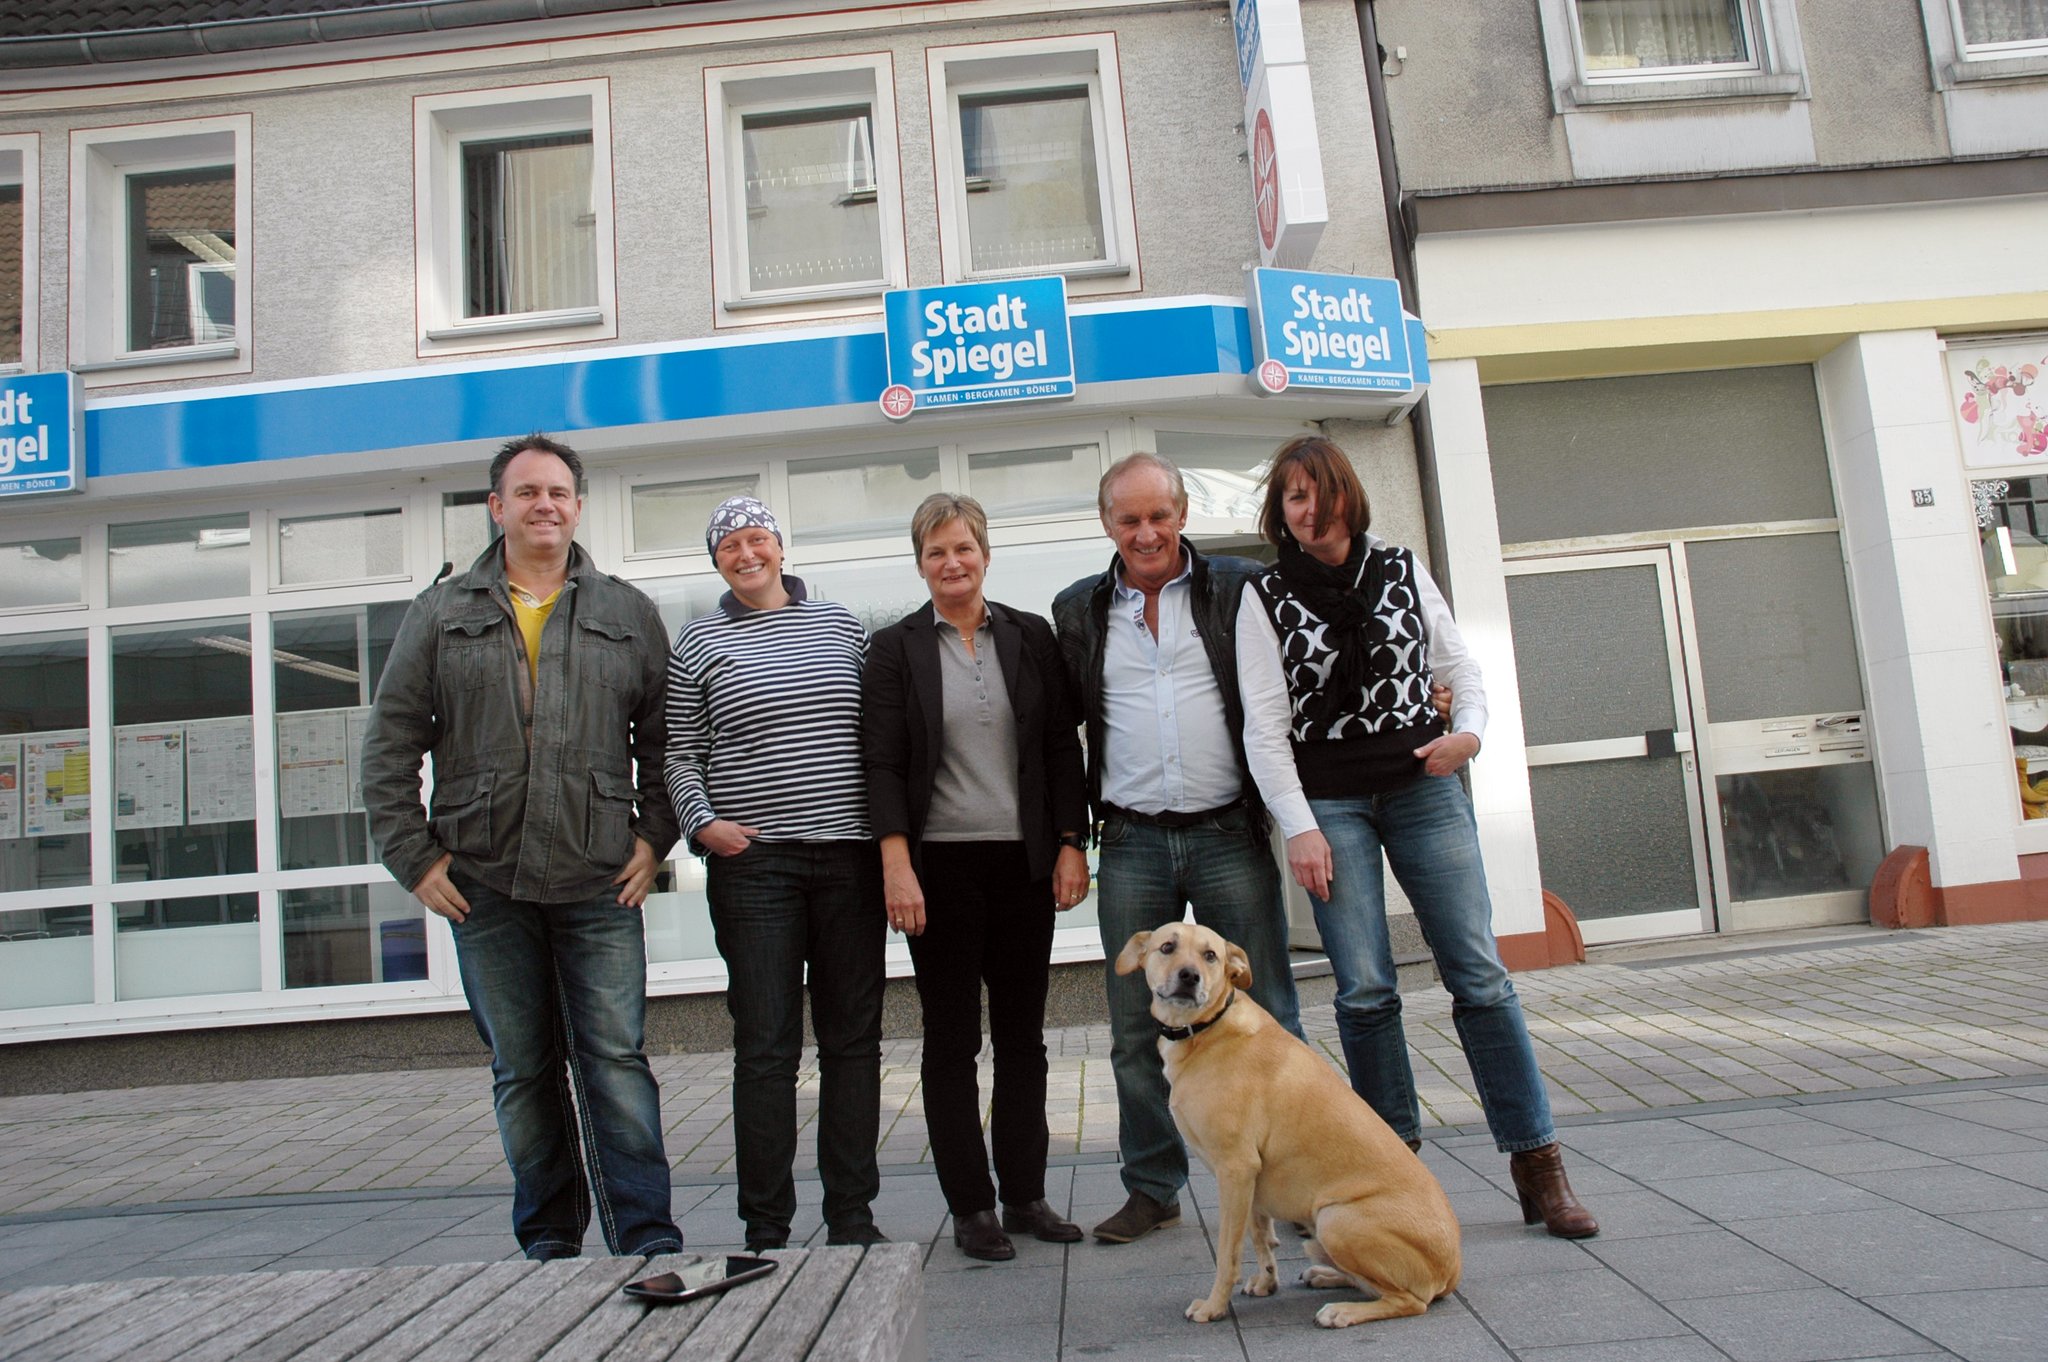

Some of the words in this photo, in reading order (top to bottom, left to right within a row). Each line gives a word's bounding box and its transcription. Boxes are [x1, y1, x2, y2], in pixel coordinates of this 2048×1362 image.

[924, 294, 1028, 337] Stadt
[1291, 285, 1374, 323] Stadt
[911, 329, 1048, 385] Spiegel
[1282, 321, 1391, 368] Spiegel
[926, 393, 959, 404] KAMEN
[965, 388, 1020, 400] BERGKAMEN
[1026, 384, 1058, 395] BÖNEN
[1298, 374, 1324, 383] KAMEN
[1329, 375, 1371, 386] BERGKAMEN
[26, 479, 56, 489] BÖNEN
[1914, 489, 1932, 505] 85
